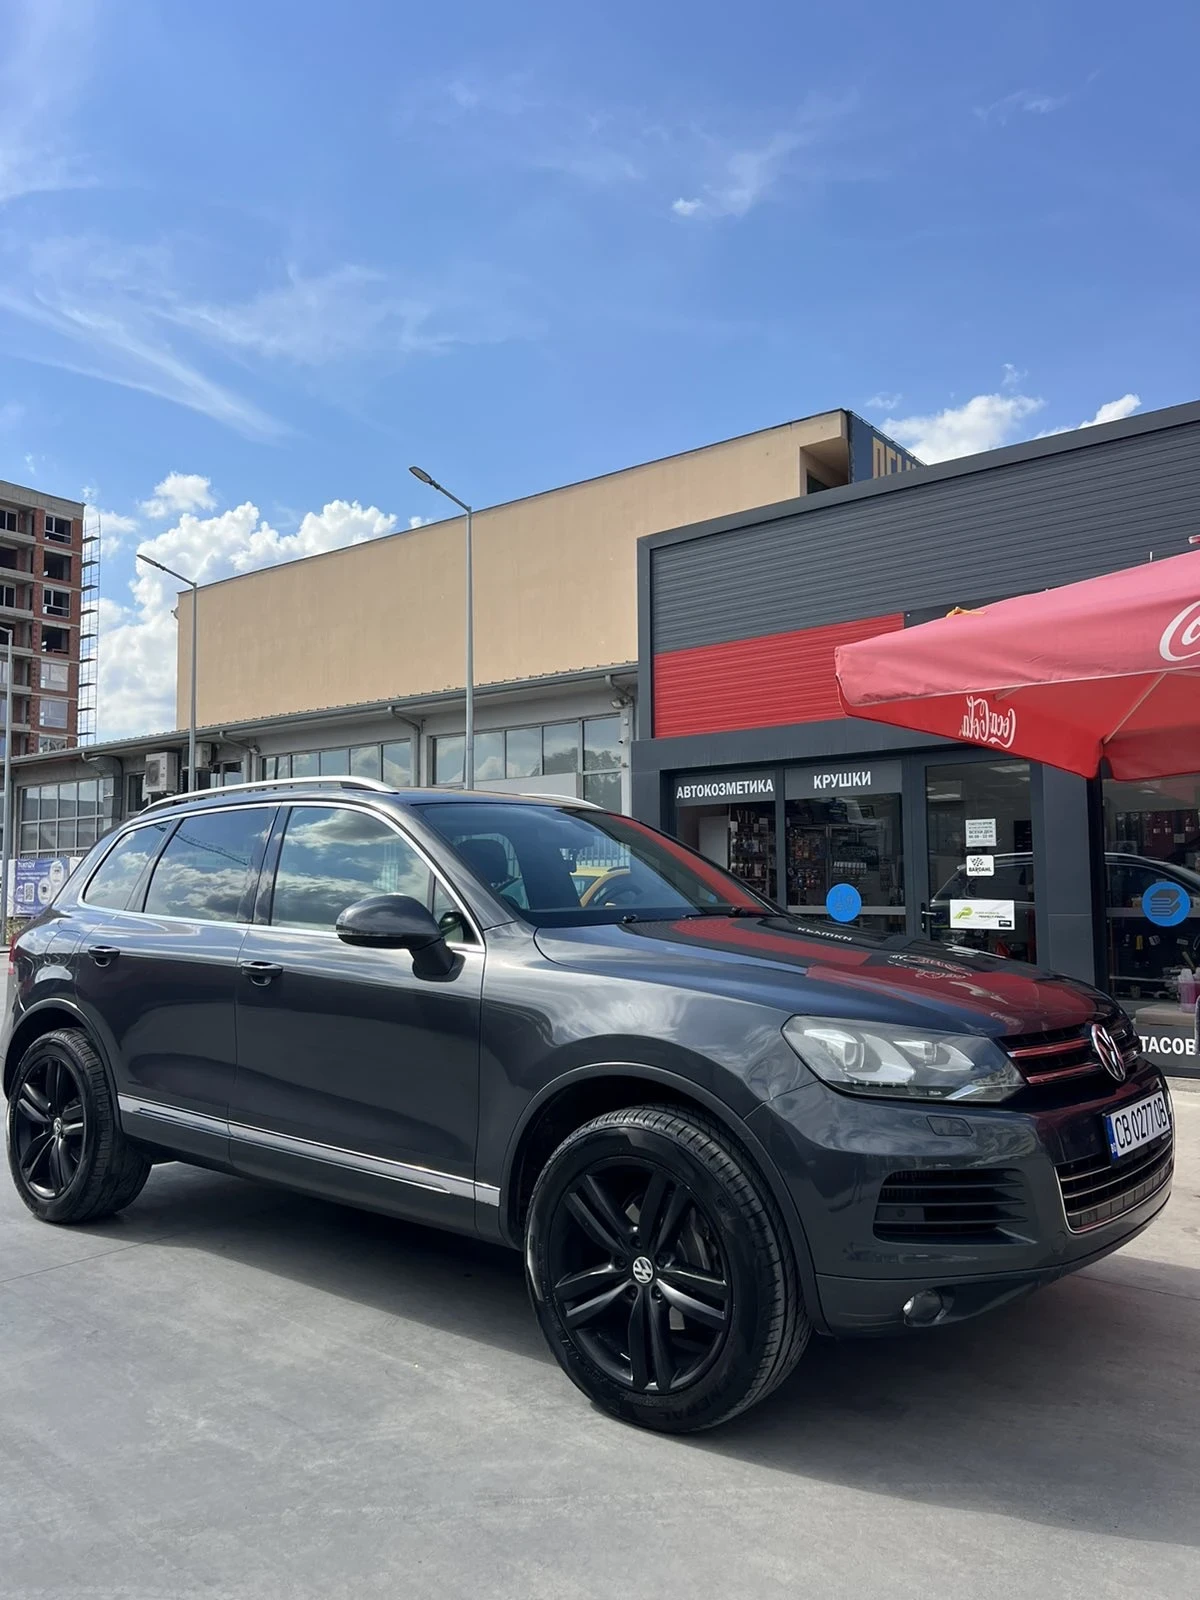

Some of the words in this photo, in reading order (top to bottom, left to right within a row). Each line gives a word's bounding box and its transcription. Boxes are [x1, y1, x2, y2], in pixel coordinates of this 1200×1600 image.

[676, 779, 773, 799] АВТОКОЗМЕТИКА
[813, 771, 871, 789] КРУШКИ
[1130, 1102, 1154, 1141] 0277
